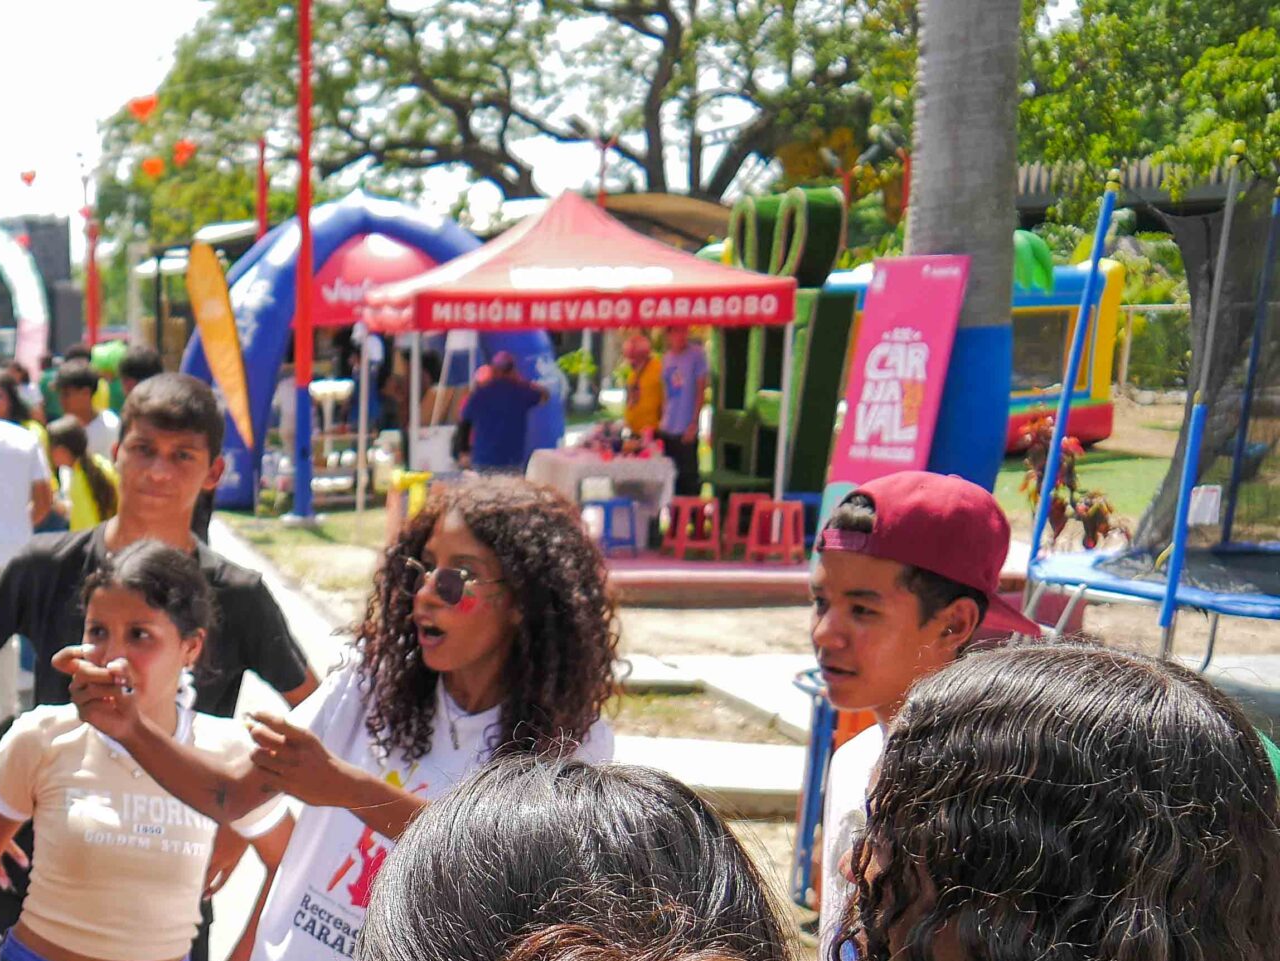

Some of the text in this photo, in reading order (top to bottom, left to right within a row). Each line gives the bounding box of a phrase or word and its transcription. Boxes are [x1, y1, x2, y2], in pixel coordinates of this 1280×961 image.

[431, 294, 778, 322] MISIÓN NEVADO CARABOBO
